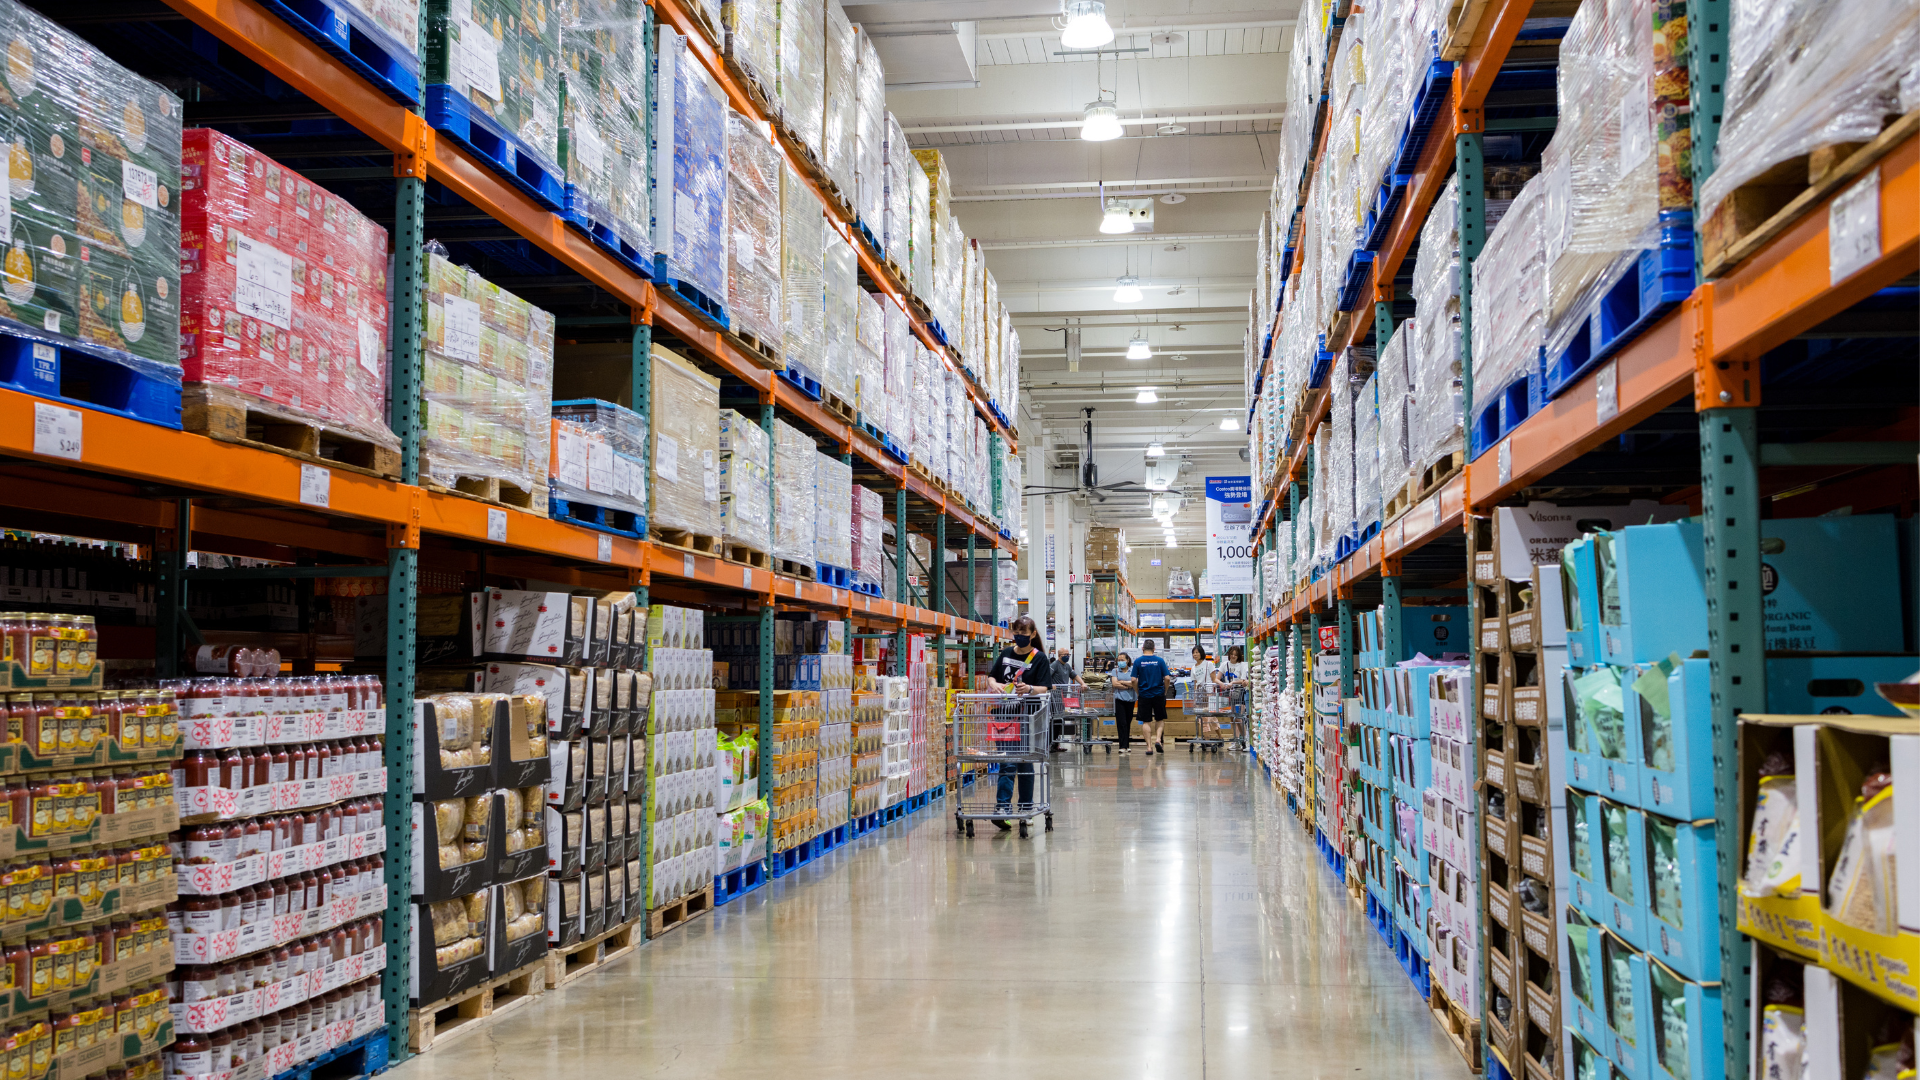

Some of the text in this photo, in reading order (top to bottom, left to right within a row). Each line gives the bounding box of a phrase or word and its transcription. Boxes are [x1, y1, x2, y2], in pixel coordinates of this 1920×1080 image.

[1529, 510, 1560, 523] Vilson
[1529, 537, 1569, 545] ORGANIC
[1529, 547, 1561, 563] 米森
